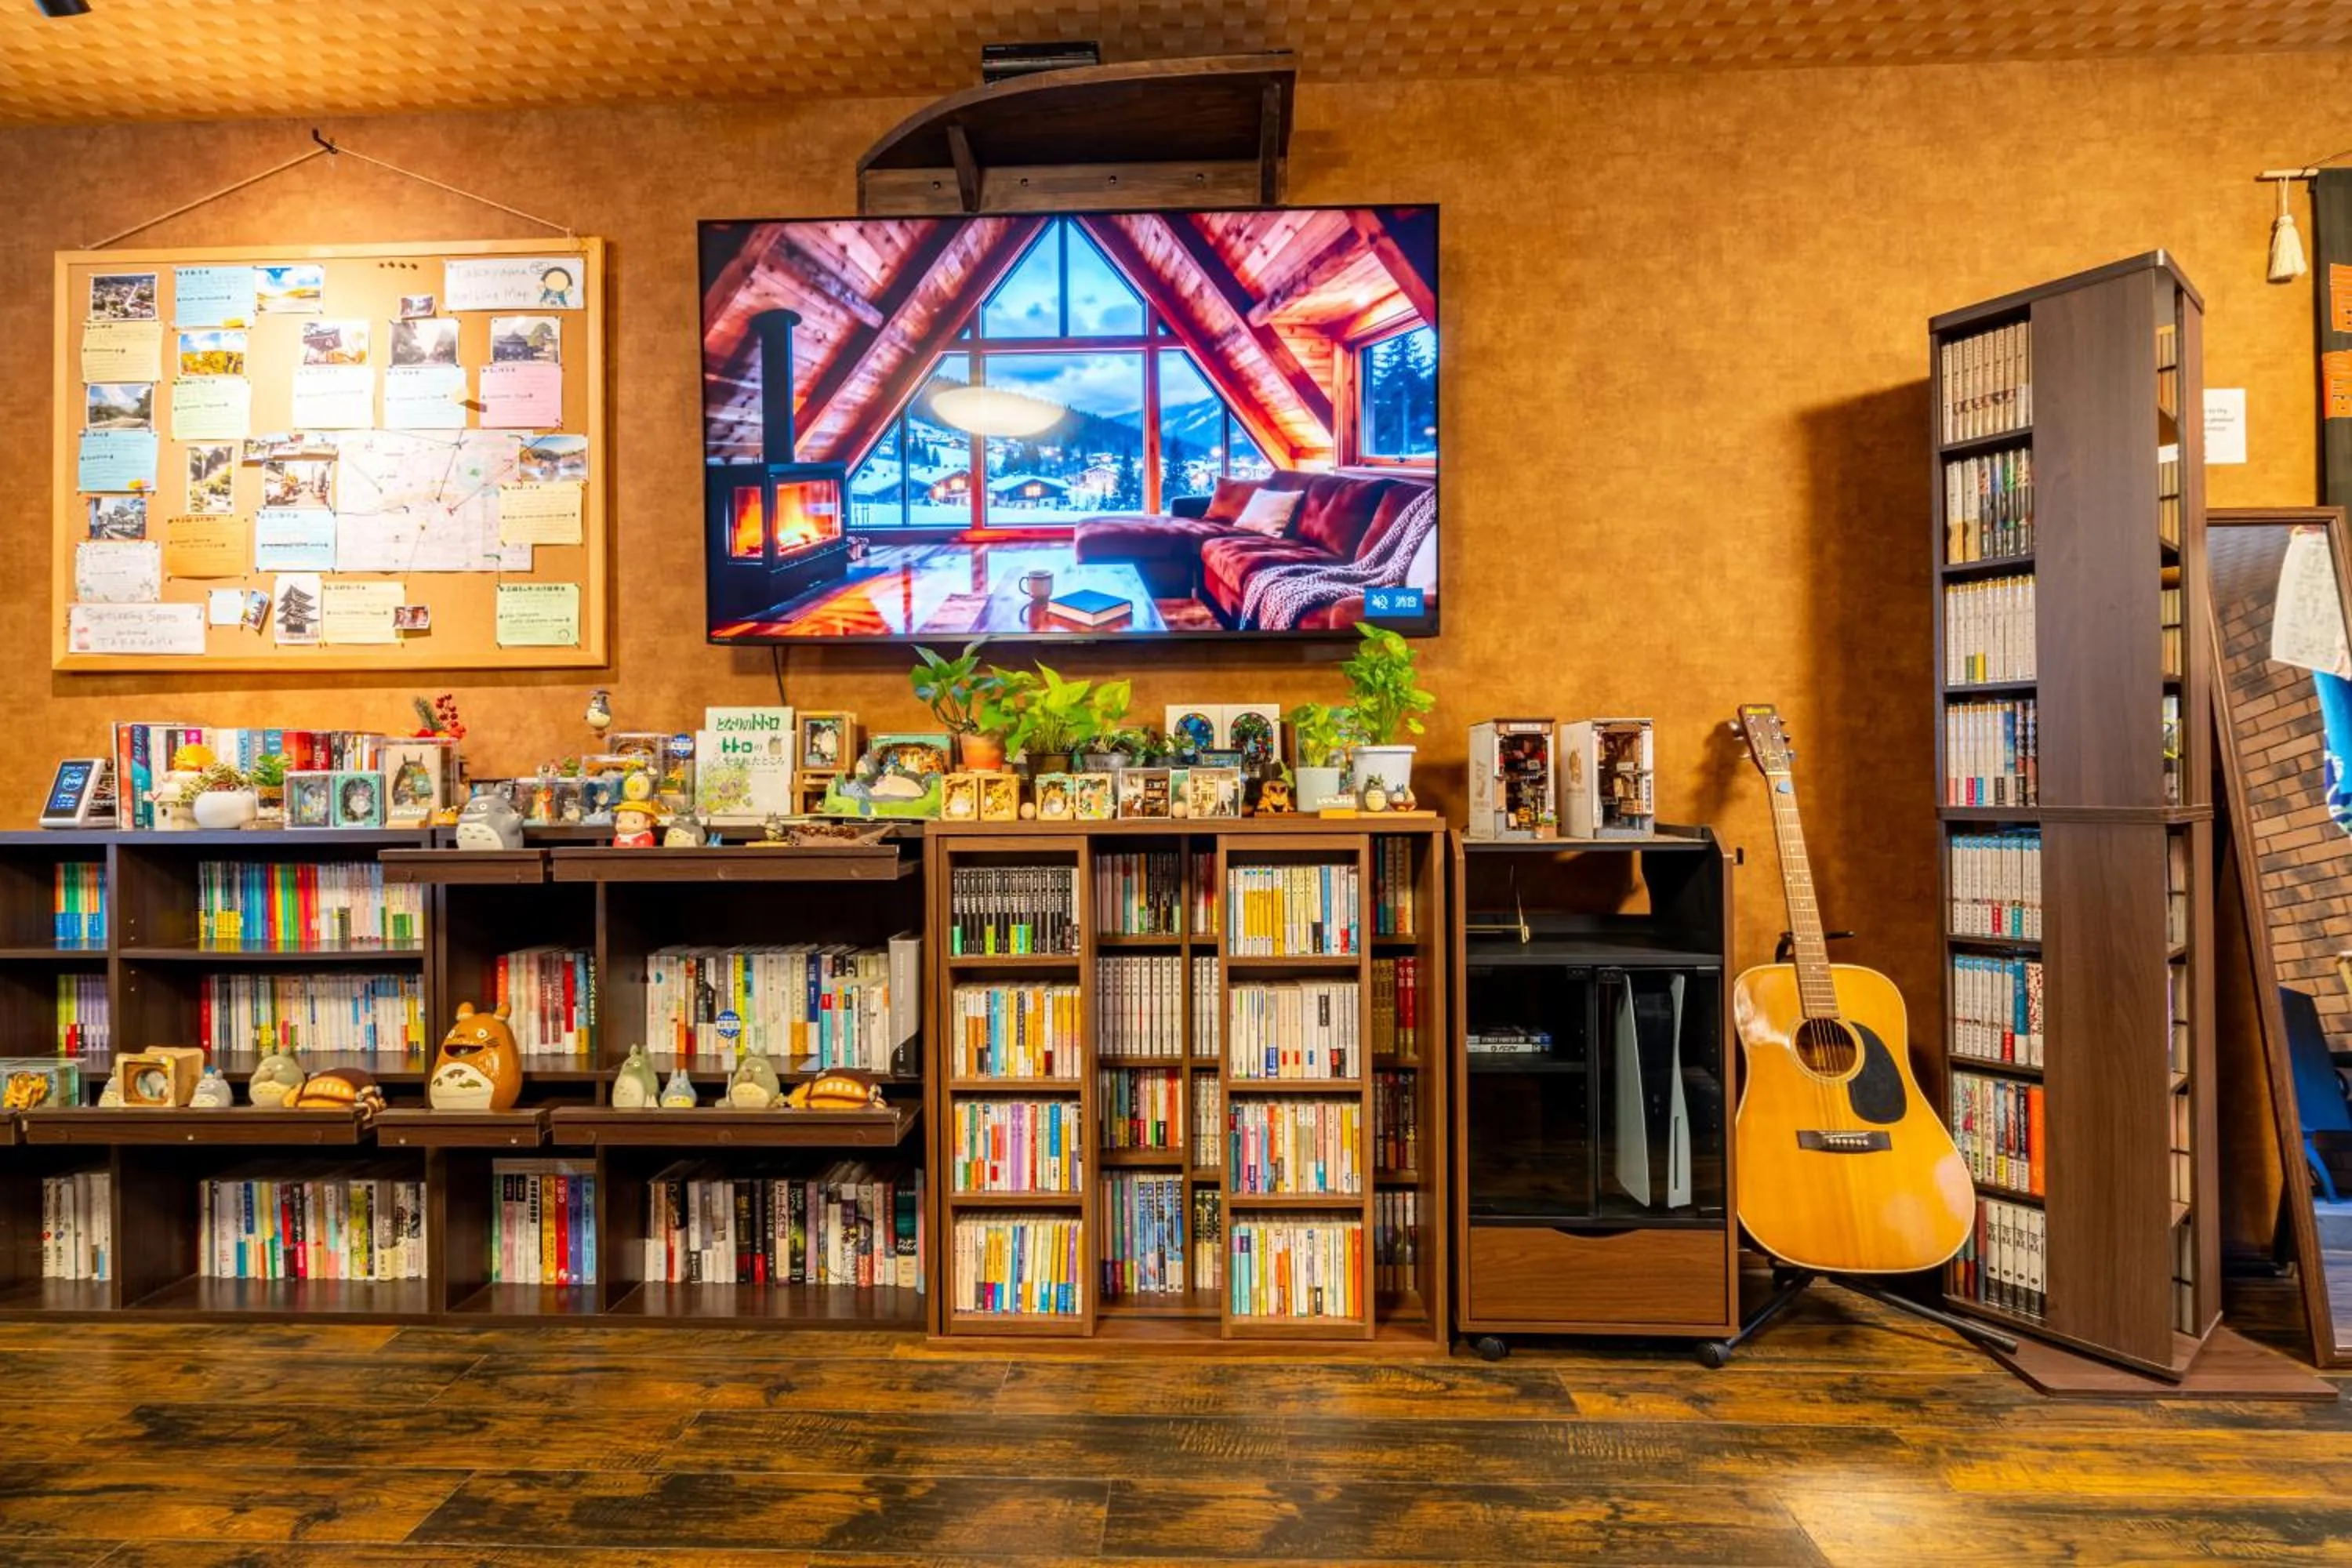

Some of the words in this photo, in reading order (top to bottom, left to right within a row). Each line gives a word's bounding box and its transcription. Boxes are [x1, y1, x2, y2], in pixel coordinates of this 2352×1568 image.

[1395, 595, 1417, 608] 消音
[716, 713, 780, 731] となりのトトロ
[720, 736, 763, 753] トトロの
